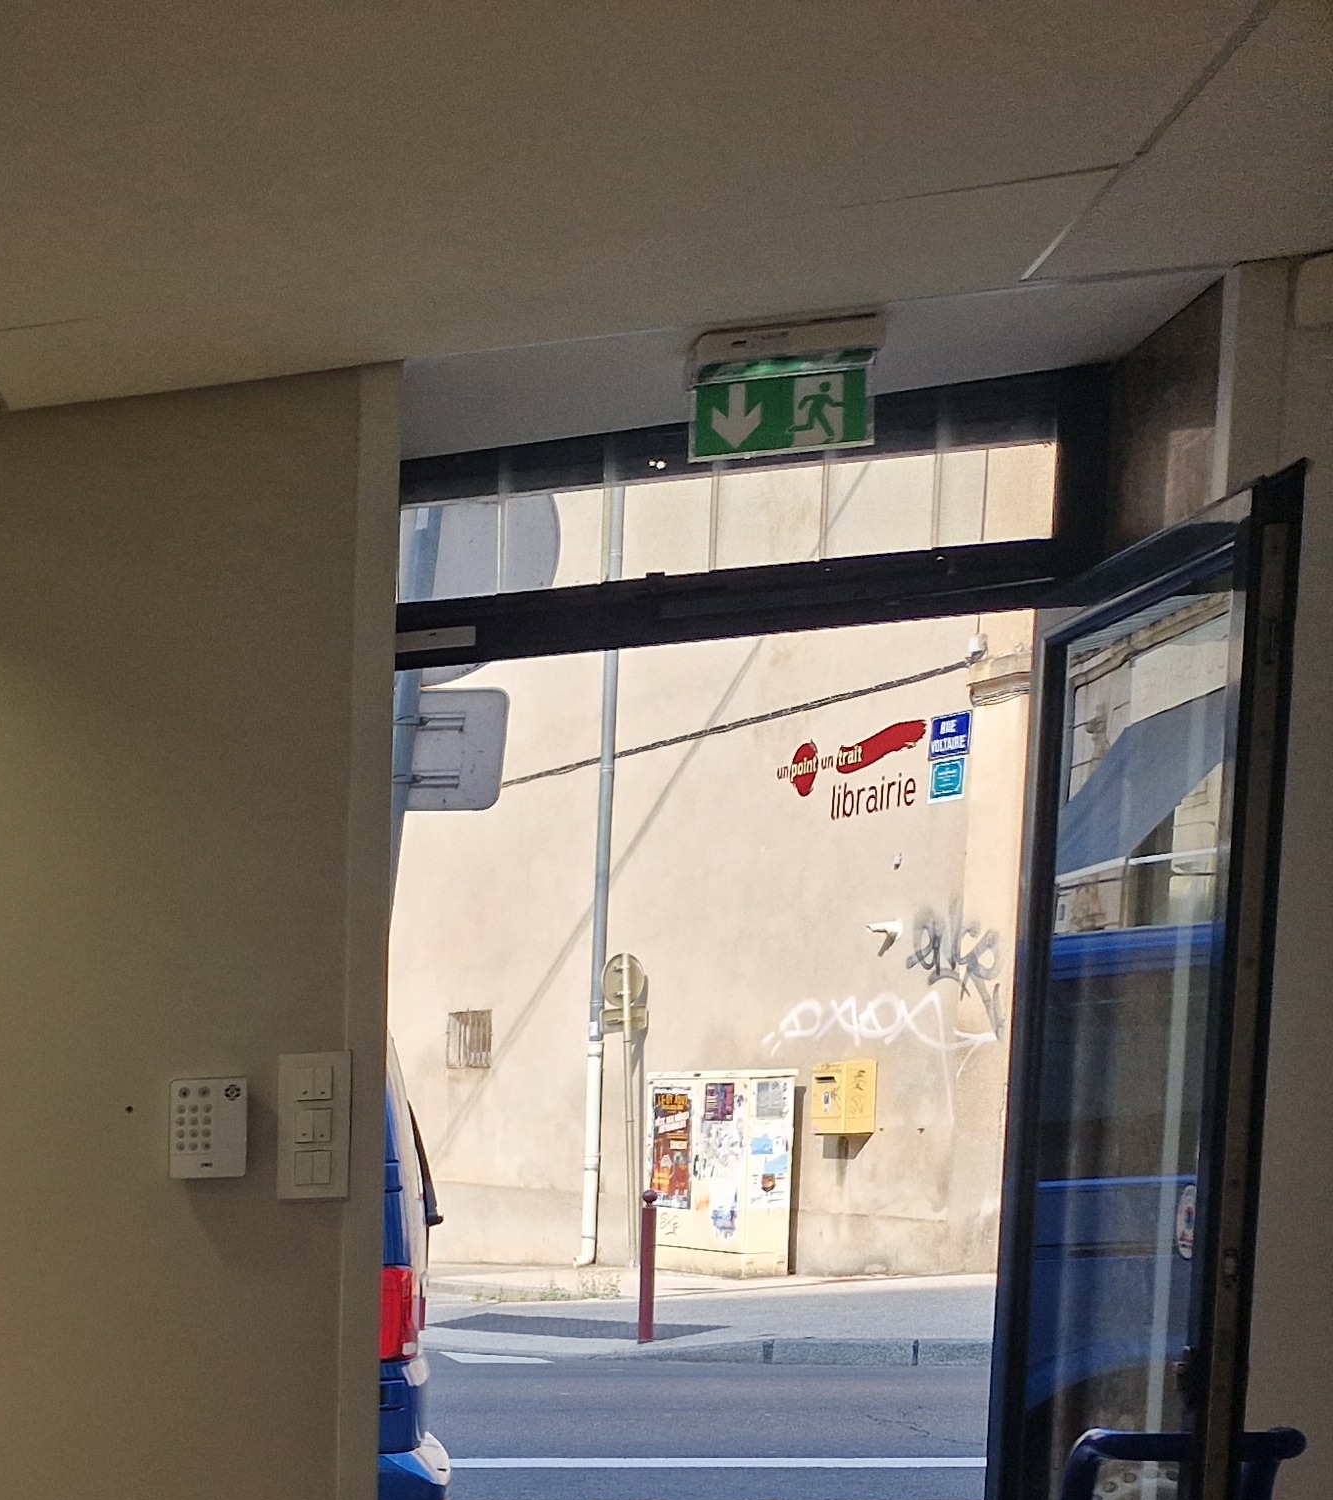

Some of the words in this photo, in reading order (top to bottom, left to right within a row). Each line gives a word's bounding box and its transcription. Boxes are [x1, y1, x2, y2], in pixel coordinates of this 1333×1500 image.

[940, 719, 958, 734] RUE
[931, 733, 967, 755] VOLTAIRE
[776, 764, 789, 779] un
[790, 755, 818, 782] point
[820, 754, 834, 770] un
[836, 745, 863, 767] trait
[830, 772, 917, 820] librairie
